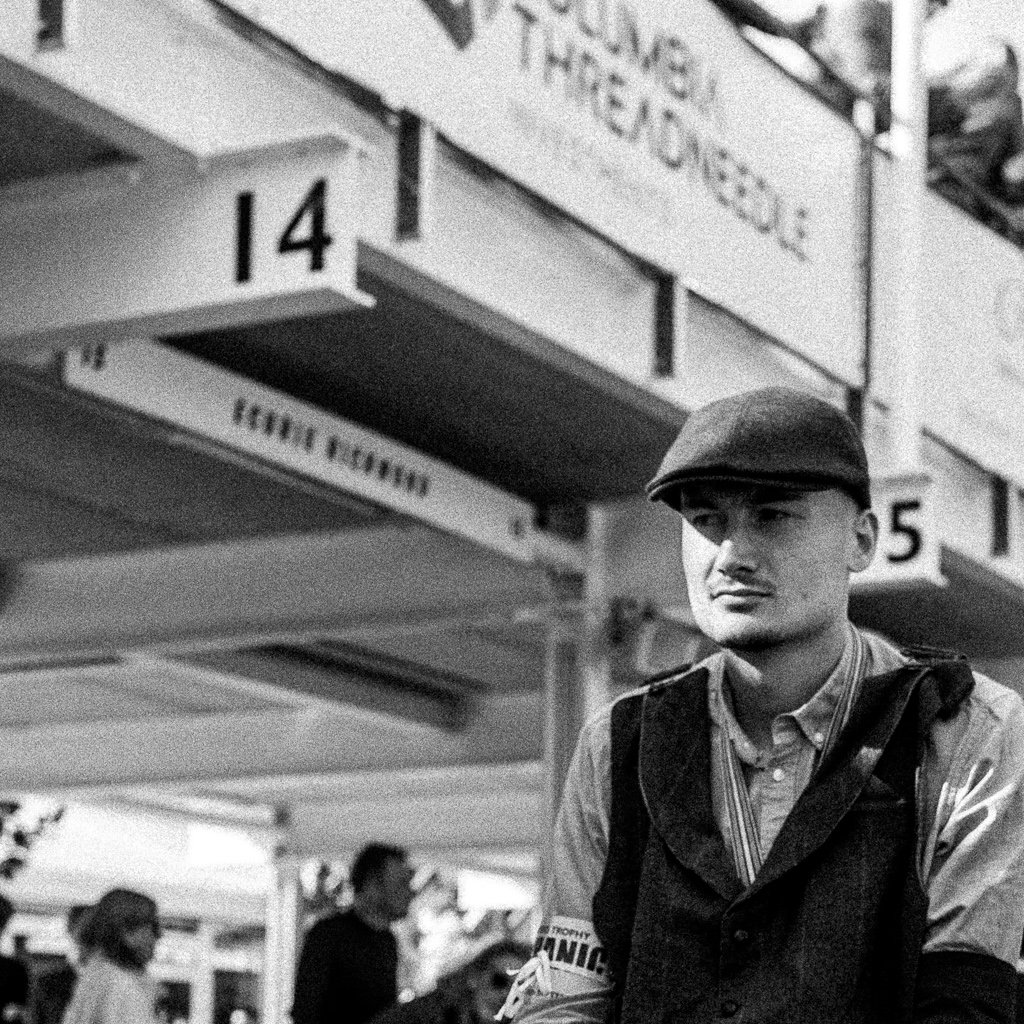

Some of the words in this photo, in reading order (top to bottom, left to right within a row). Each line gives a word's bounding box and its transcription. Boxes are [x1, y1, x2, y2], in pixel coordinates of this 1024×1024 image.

[236, 176, 333, 283] 14
[886, 500, 921, 562] 5
[552, 925, 591, 940] TROPHY
